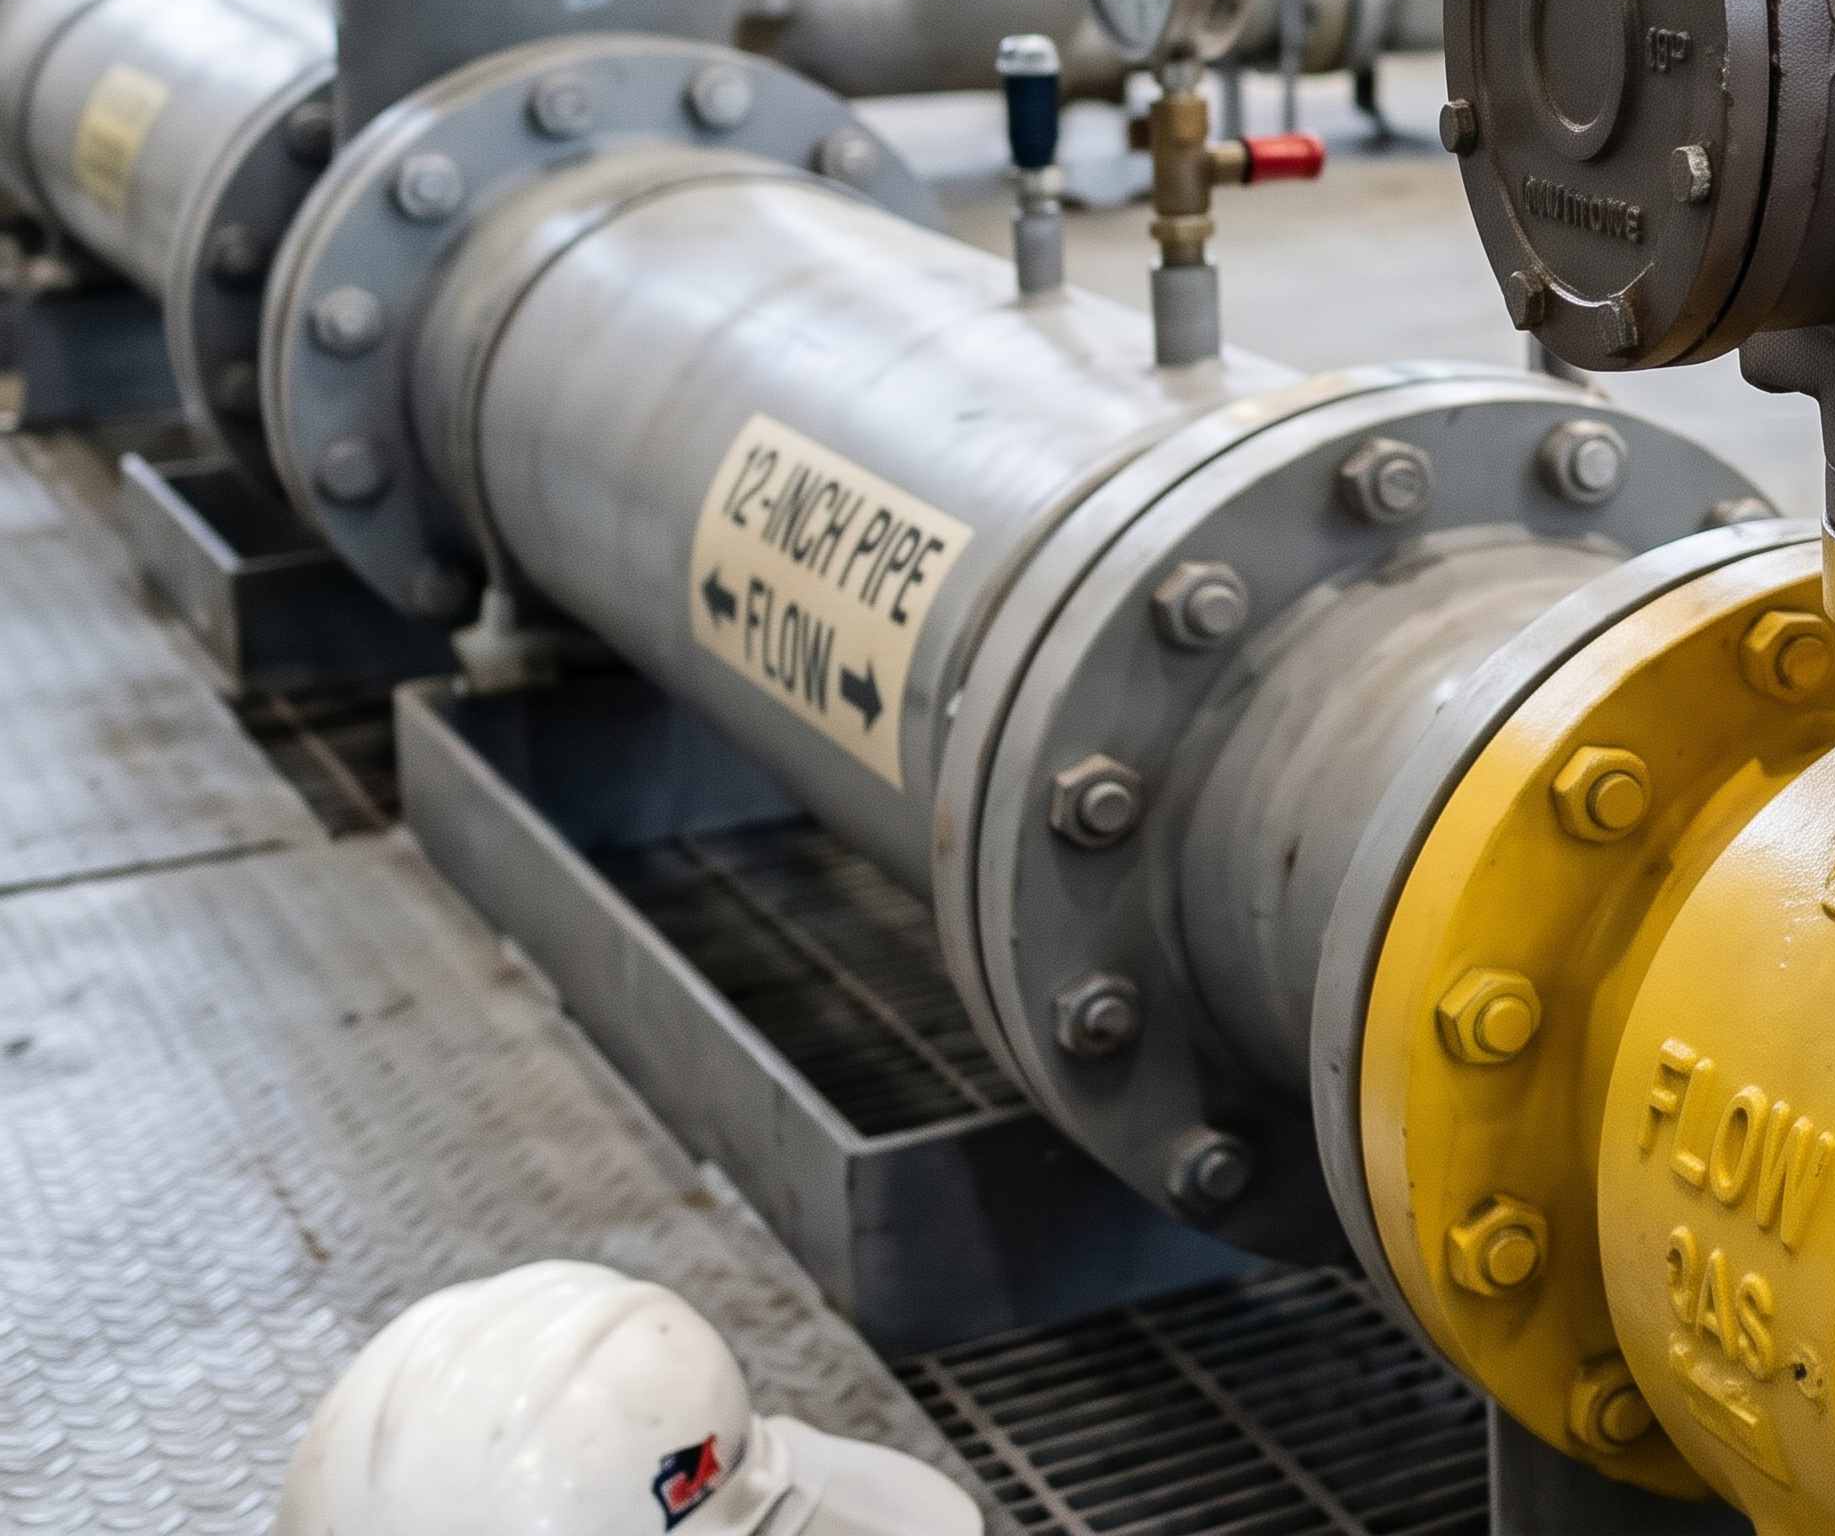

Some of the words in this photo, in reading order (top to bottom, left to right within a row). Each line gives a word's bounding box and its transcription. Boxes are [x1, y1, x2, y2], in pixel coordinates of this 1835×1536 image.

[722, 443, 859, 576] 12-INCH
[837, 505, 946, 627] PIPE
[743, 576, 836, 714] FLOW
